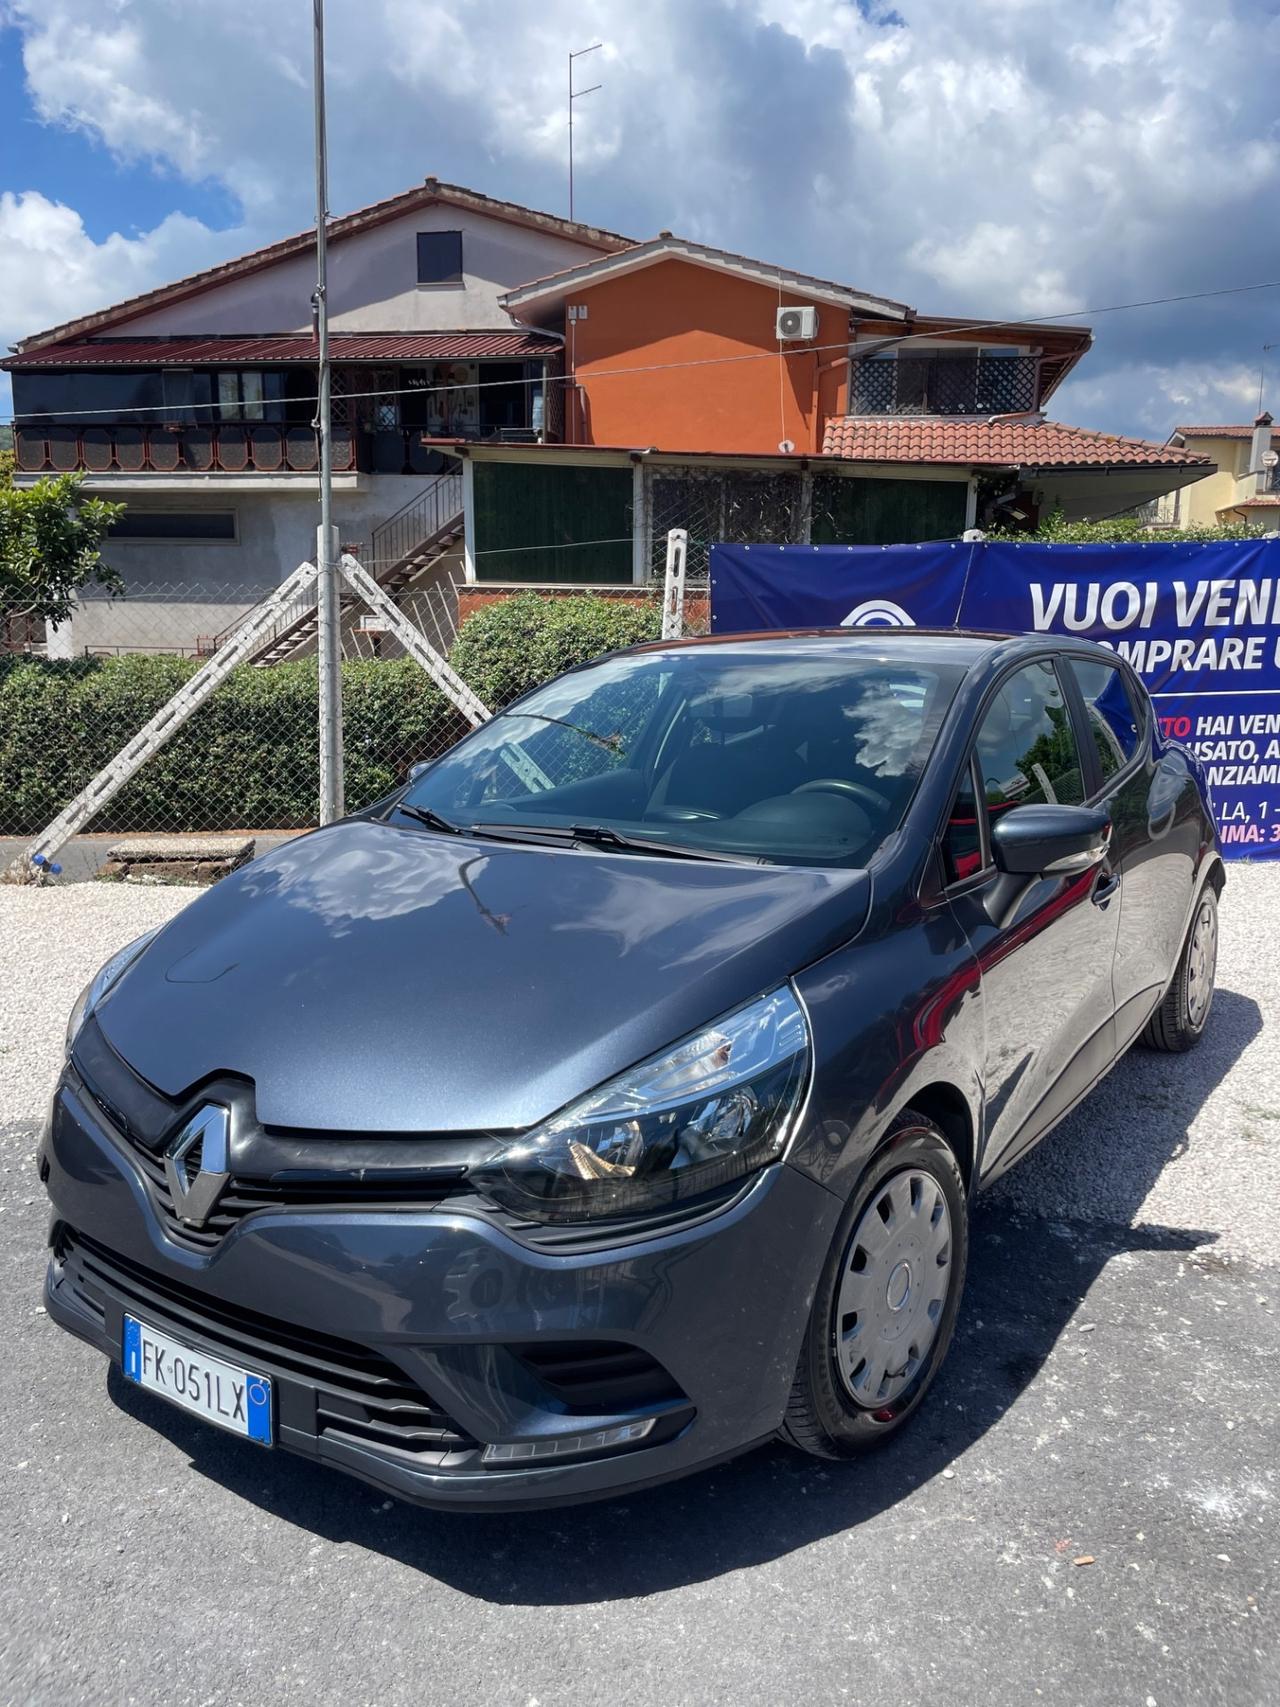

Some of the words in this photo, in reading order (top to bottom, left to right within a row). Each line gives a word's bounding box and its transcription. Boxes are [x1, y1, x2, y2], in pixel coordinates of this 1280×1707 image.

[1029, 581, 1158, 631] VUOI
[1158, 717, 1191, 737] TO
[1196, 715, 1234, 736] HAI
[1207, 764, 1280, 786] NZIAM
[1258, 801, 1268, 819] 1
